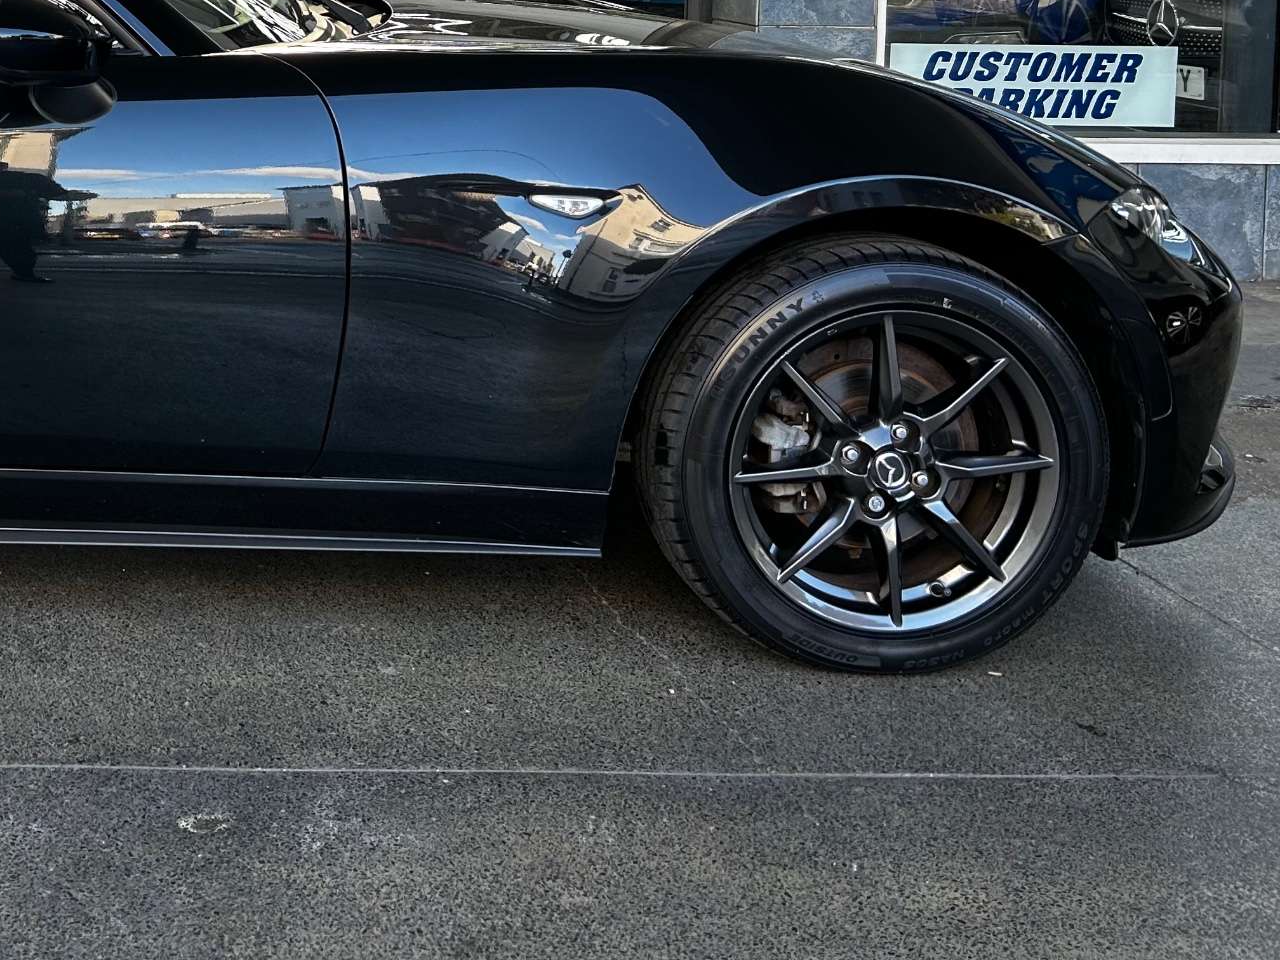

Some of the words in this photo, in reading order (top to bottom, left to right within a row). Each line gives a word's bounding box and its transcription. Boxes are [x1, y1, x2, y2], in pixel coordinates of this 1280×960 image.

[923, 51, 1144, 83] CUSTOMER
[954, 87, 1122, 119] RKING
[717, 296, 807, 384] SUNNY
